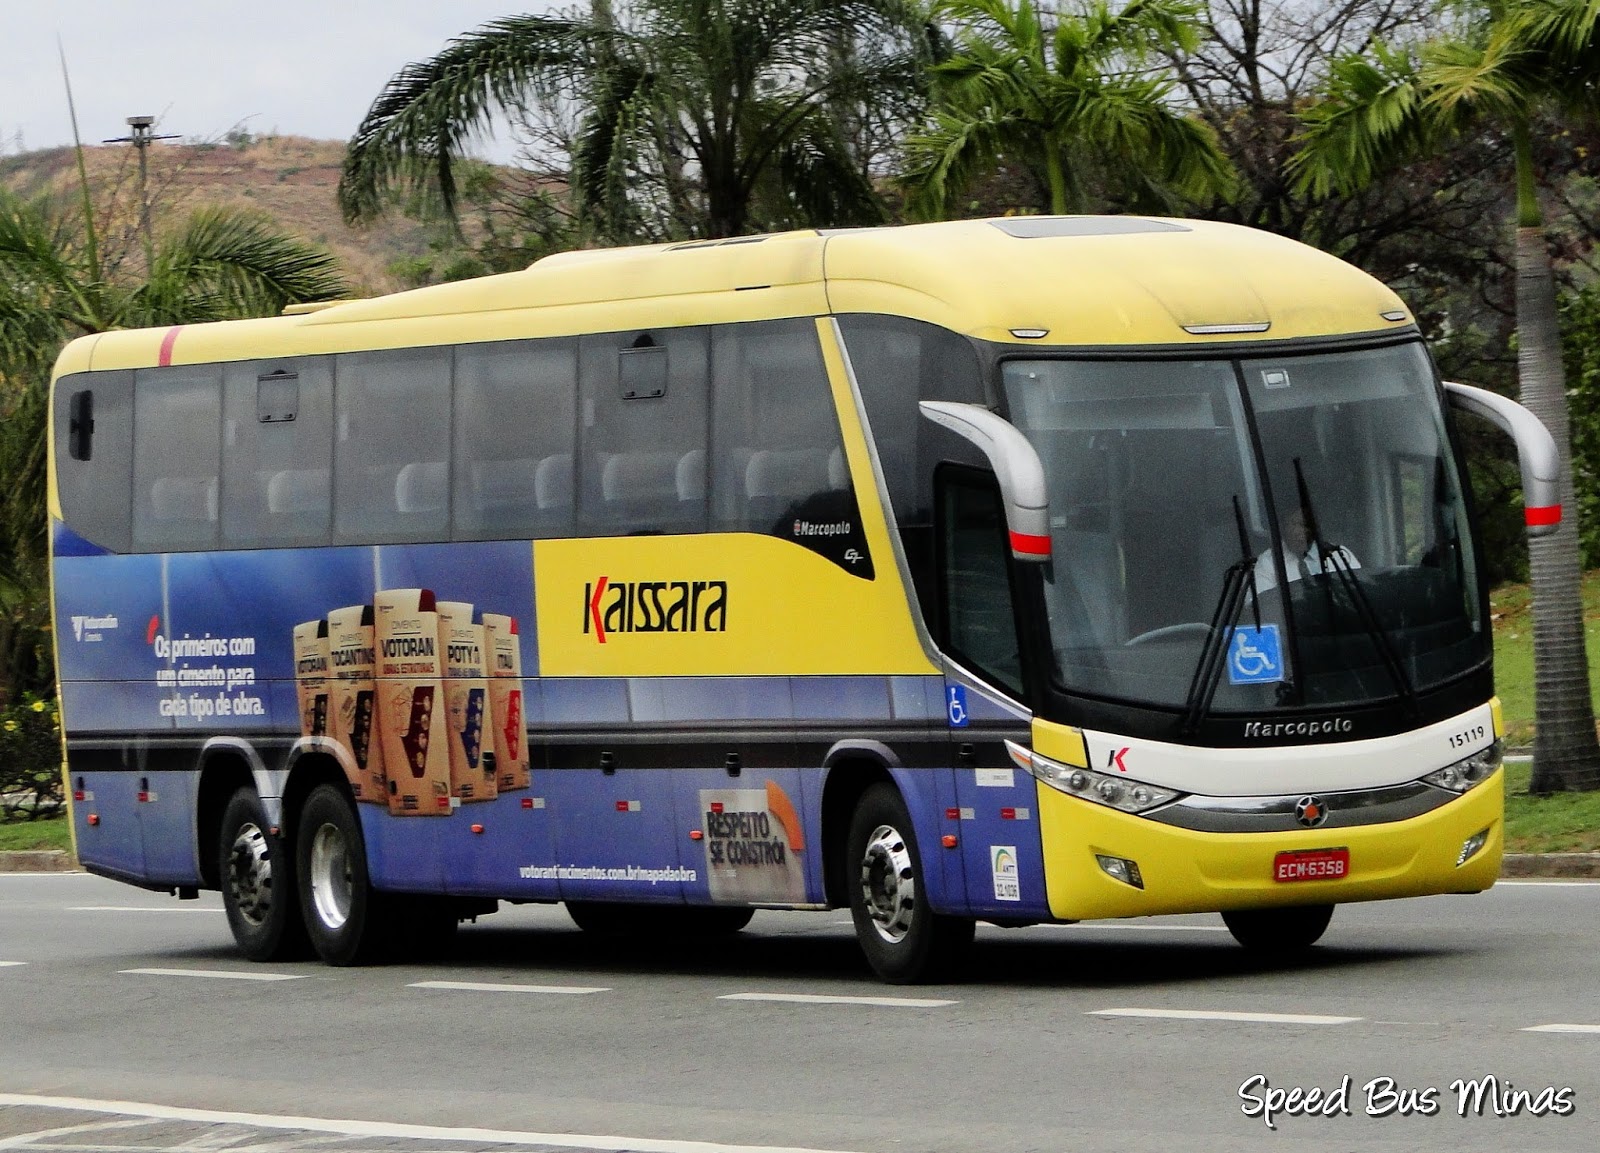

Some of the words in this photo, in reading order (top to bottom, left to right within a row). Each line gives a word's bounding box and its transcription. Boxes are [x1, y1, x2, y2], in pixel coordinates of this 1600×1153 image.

[801, 521, 851, 537] Marcopolo
[583, 576, 727, 643] Kaissara
[154, 635, 171, 658] Os
[171, 633, 228, 664] primeiros
[228, 637, 256, 656] com
[381, 637, 435, 658] VOTORAN
[447, 645, 473, 664] POTY
[156, 669, 177, 688] um
[177, 663, 226, 687] cimento
[226, 667, 255, 692] para
[160, 692, 187, 717] cada
[189, 692, 214, 722] tipo
[215, 691, 232, 716] de
[232, 690, 265, 716] obra.
[1244, 717, 1353, 738] Marcopolo
[1449, 725, 1484, 749] 15119
[706, 811, 770, 838] RESPEITO
[709, 840, 725, 864] SE
